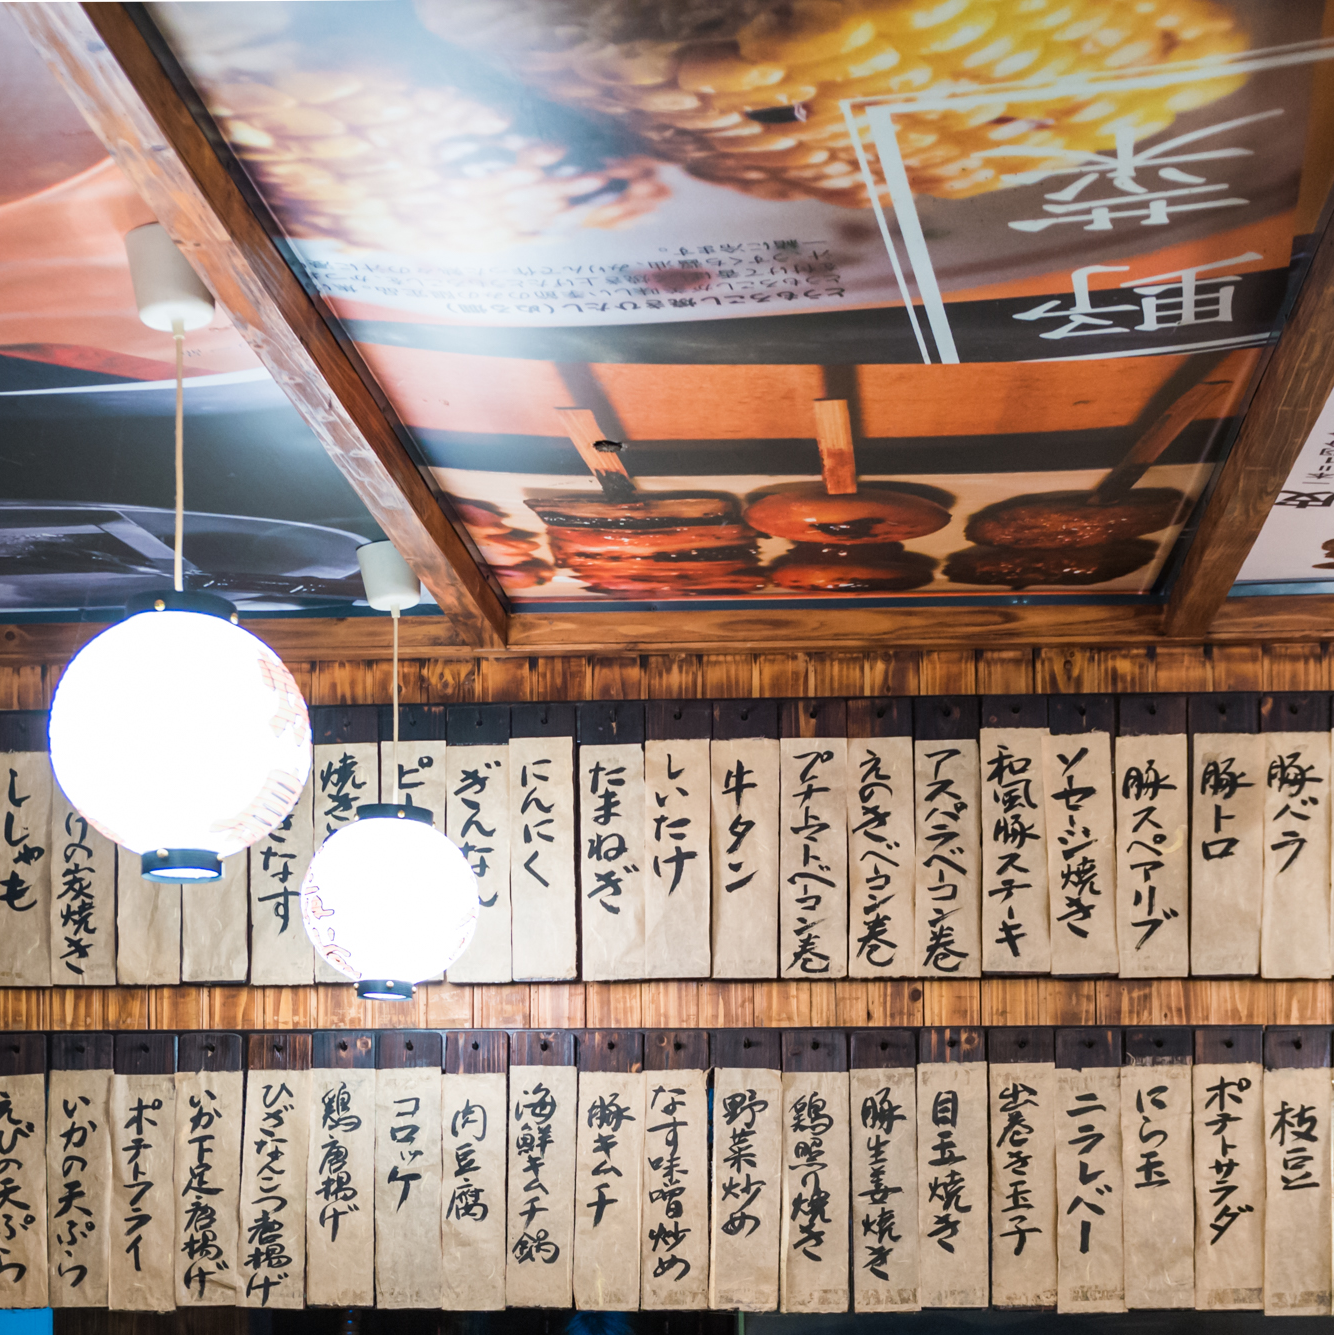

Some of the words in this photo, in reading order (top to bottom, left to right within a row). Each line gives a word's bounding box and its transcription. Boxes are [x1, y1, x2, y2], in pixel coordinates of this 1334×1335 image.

[968, 108, 1284, 339] 野菜
[521, 759, 554, 887] にんにく
[588, 762, 639, 914] たまねぎ
[653, 754, 697, 895] しいたけ
[722, 760, 757, 893] 牛タン
[1122, 759, 1179, 951] 豚スペアリブ
[1201, 758, 1255, 861] 豚トロ
[1267, 752, 1323, 873] 豚バラ
[57, 812, 97, 975] りの炭焼き
[54, 1096, 97, 1287] いかの天ぷら
[122, 1098, 162, 1271] ポテトフライ
[388, 1098, 423, 1211] コロッケ
[446, 1100, 488, 1221] 肉豆腐
[512, 1083, 559, 1264] 海鮮キムチ鍋
[587, 1093, 636, 1227] 豚キムチ
[647, 1086, 691, 1281] なす味噌炒め
[721, 1089, 768, 1237] 野菜炒め
[927, 1090, 972, 1253] 目玉焼き
[1135, 1086, 1170, 1188] にら玉
[1205, 1076, 1254, 1245] ポテトサラダ
[1271, 1101, 1320, 1190] 枝豆
